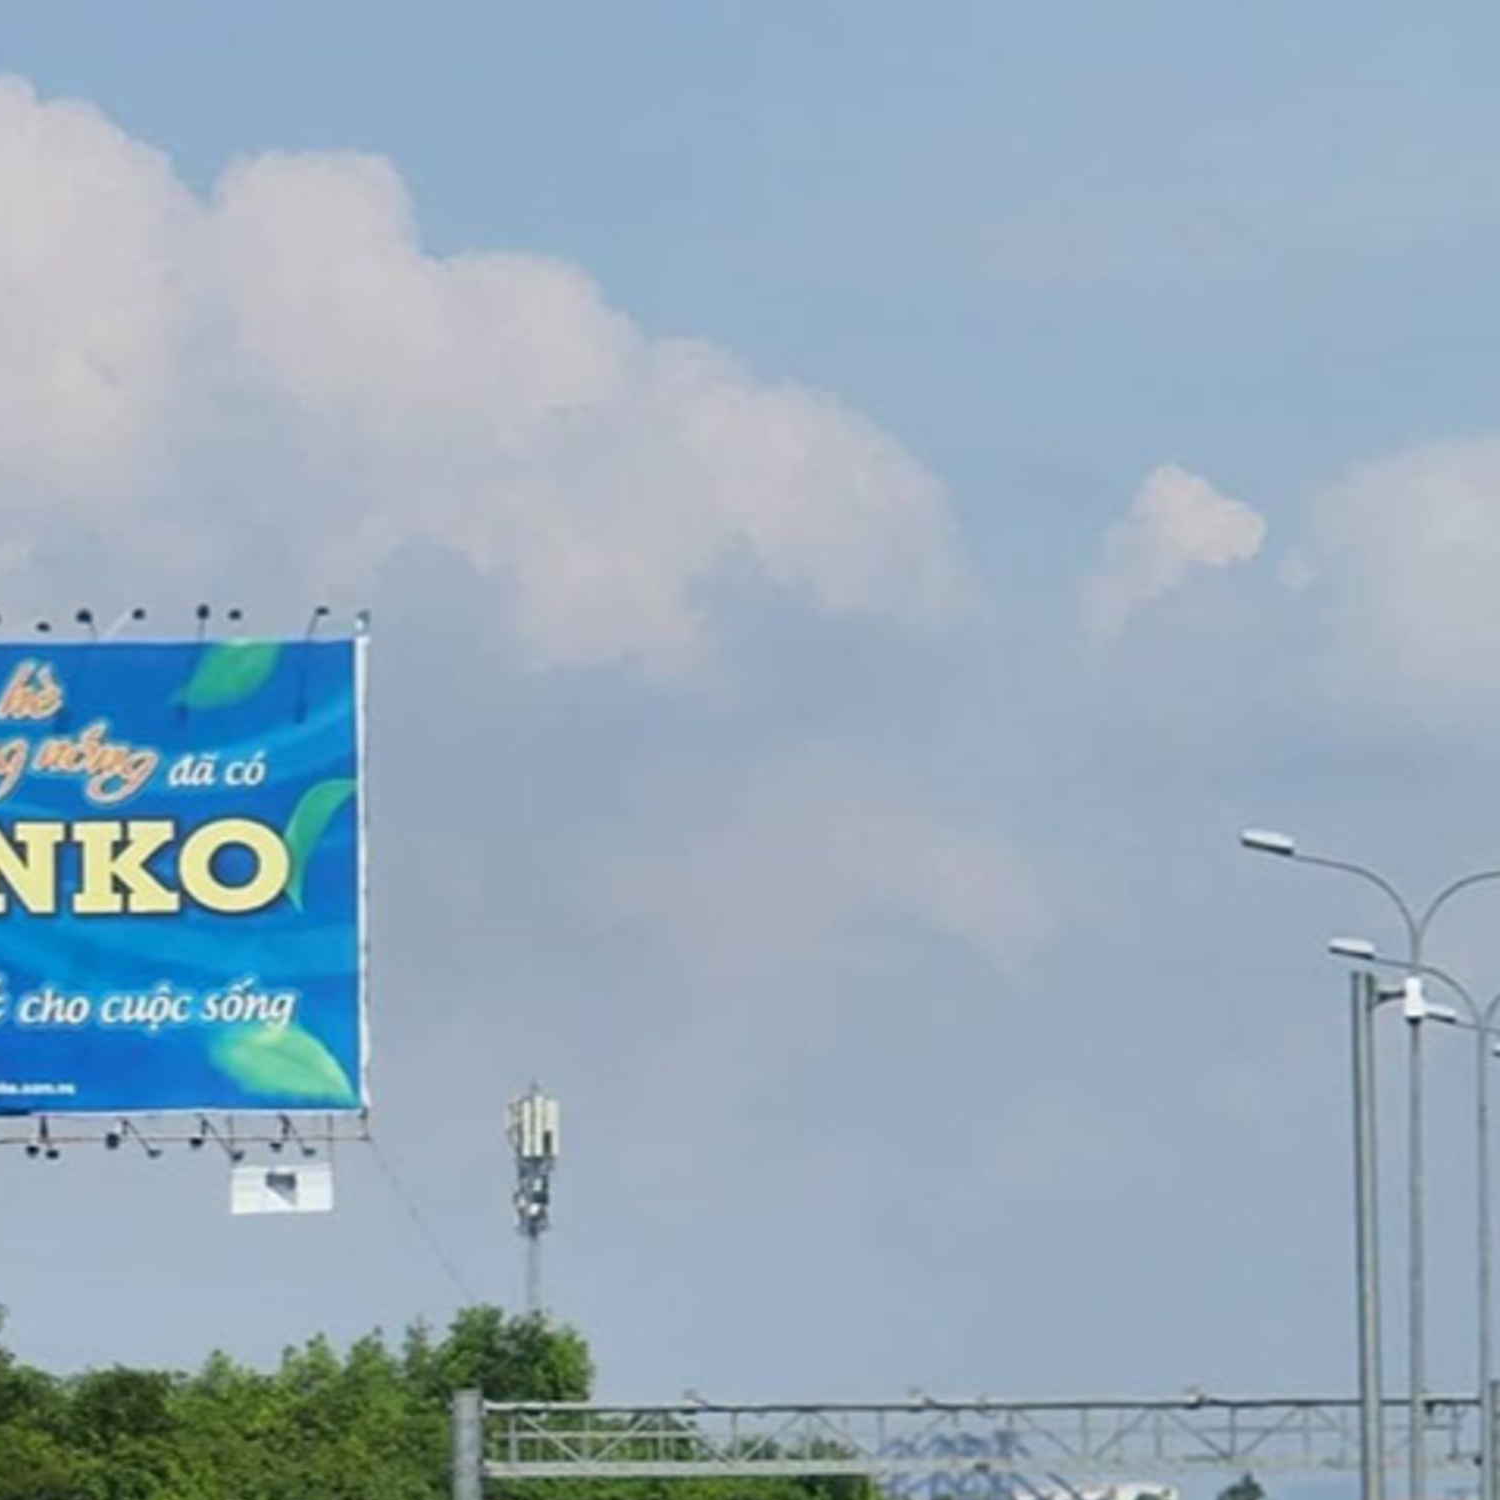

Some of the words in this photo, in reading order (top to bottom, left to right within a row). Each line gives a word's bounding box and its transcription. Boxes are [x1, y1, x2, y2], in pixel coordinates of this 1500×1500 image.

[168, 754, 217, 787] đã
[224, 752, 266, 787] có
[19, 988, 90, 1026] cho
[101, 991, 190, 1031] cuộc
[203, 976, 295, 1030] sống
